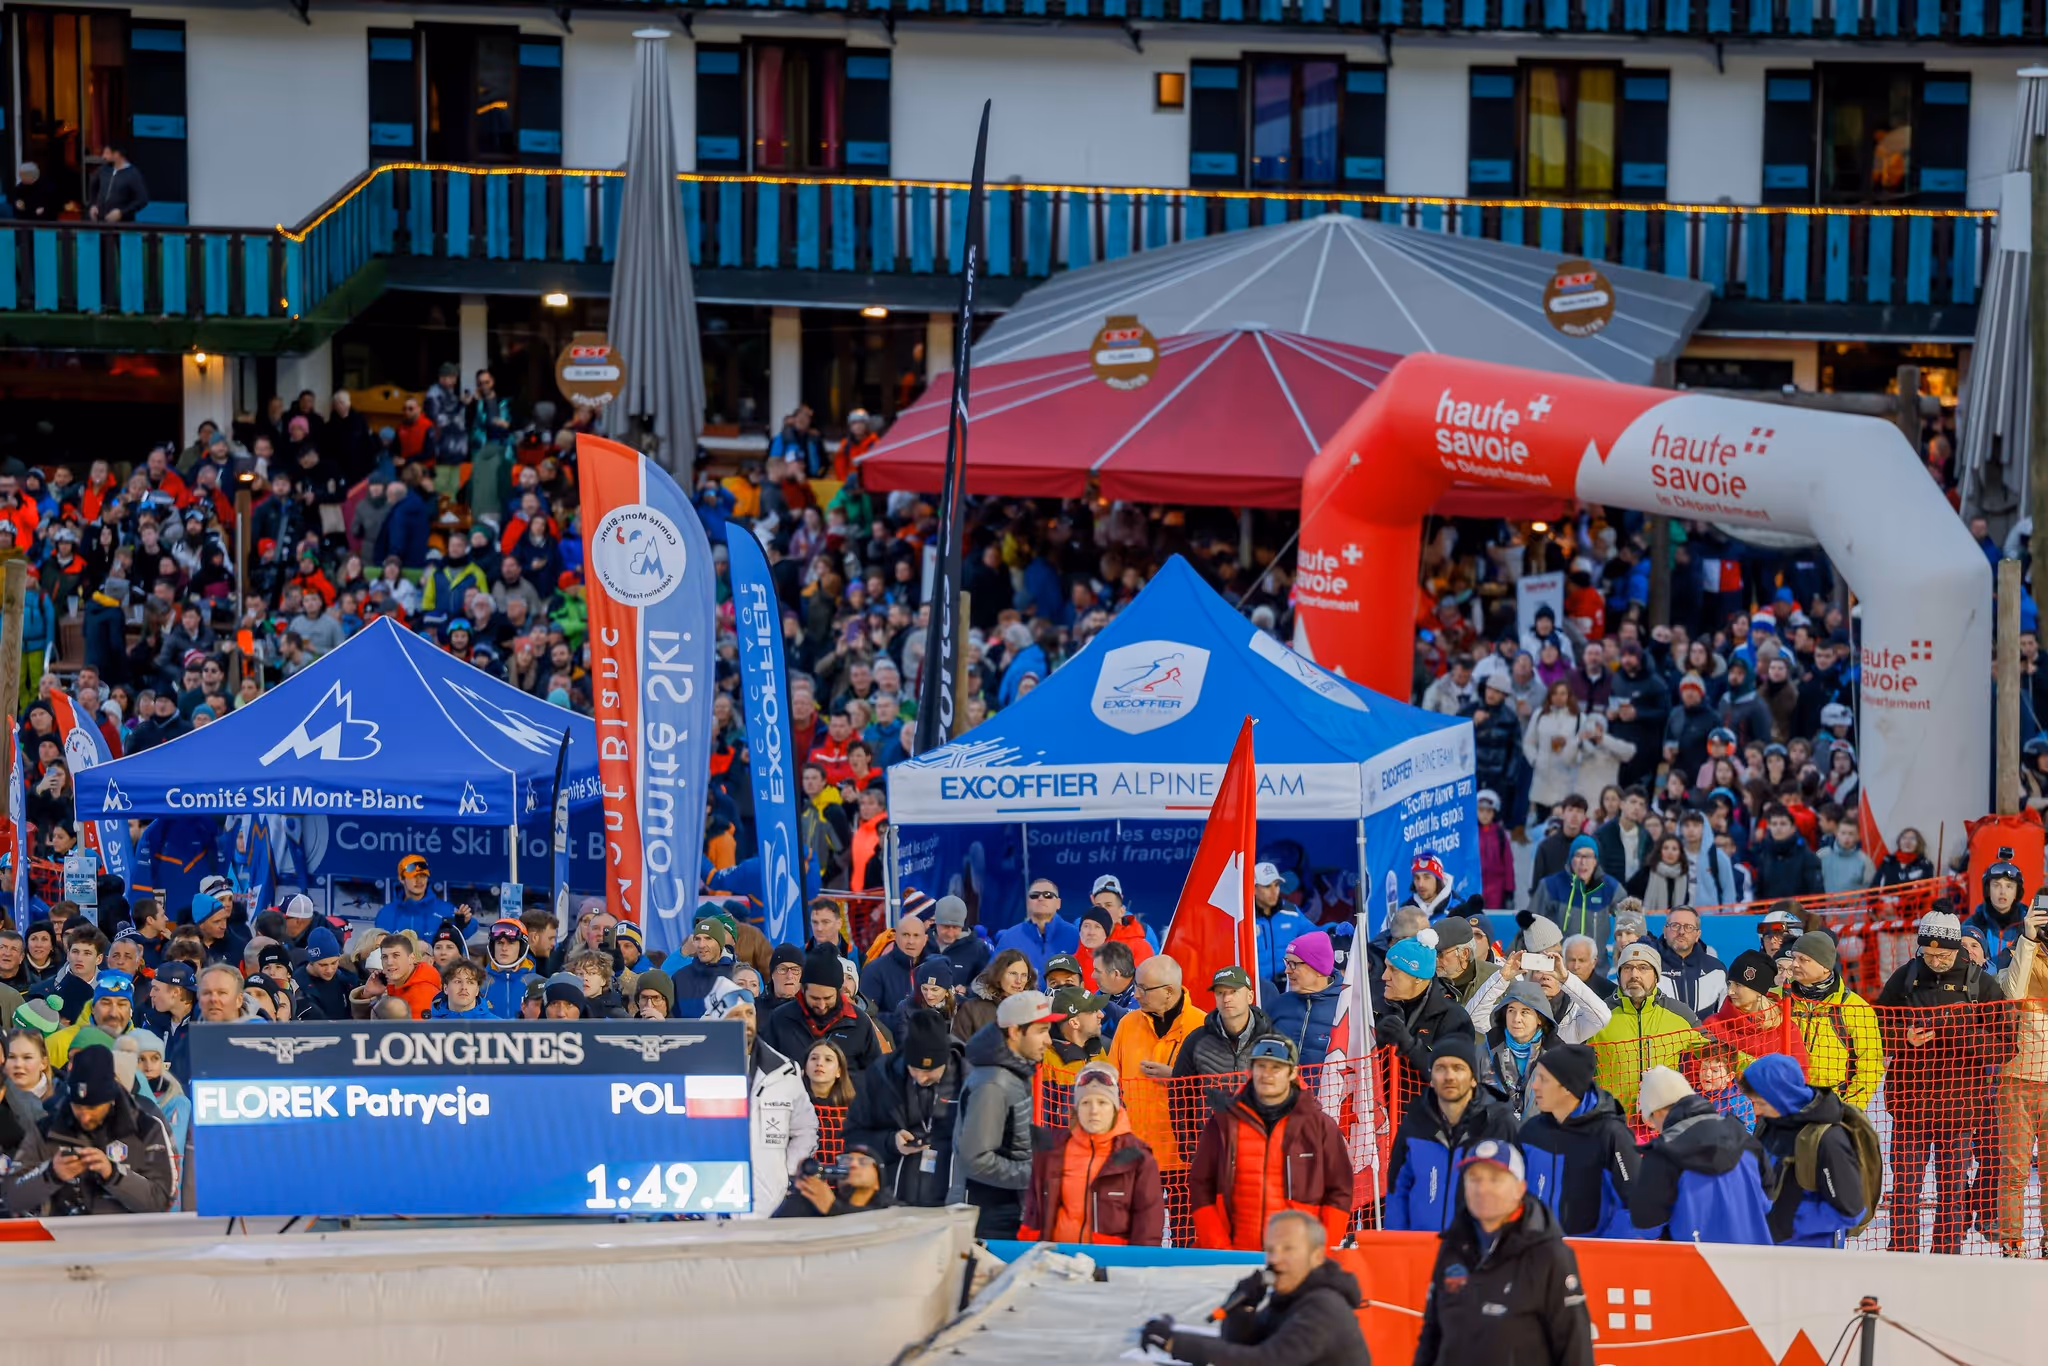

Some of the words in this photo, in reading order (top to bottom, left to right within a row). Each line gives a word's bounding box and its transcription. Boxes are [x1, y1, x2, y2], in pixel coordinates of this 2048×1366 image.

[1435, 388, 1520, 434] haute
[1436, 428, 1529, 465] savoie
[1651, 424, 1737, 467] haute
[1652, 464, 1747, 500] savoie
[1297, 548, 1339, 573] aute
[1296, 570, 1348, 595] avoie
[1862, 648, 1907, 671] aute
[1862, 670, 1918, 693] avoie
[1103, 699, 1181, 709] EXCOFFIER
[165, 786, 247, 808] Comité
[253, 786, 286, 807] Ski
[292, 786, 424, 809] Mont-Blanc
[940, 772, 1098, 800] EXCOFFIER
[1111, 772, 1213, 796] ALPINE
[1257, 773, 1305, 796] AM
[336, 822, 442, 853] Comité
[452, 826, 491, 855] Ski
[503, 829, 577, 858] Mot
[1028, 828, 1110, 847] Soutient
[1056, 849, 1081, 865] du
[1088, 846, 1116, 863] ski
[351, 1031, 585, 1066] LONGINES
[198, 1085, 339, 1119] FLOREK
[346, 1085, 490, 1125] Patrycja
[611, 1082, 686, 1115] POL
[586, 1162, 750, 1209] 1:49.4
